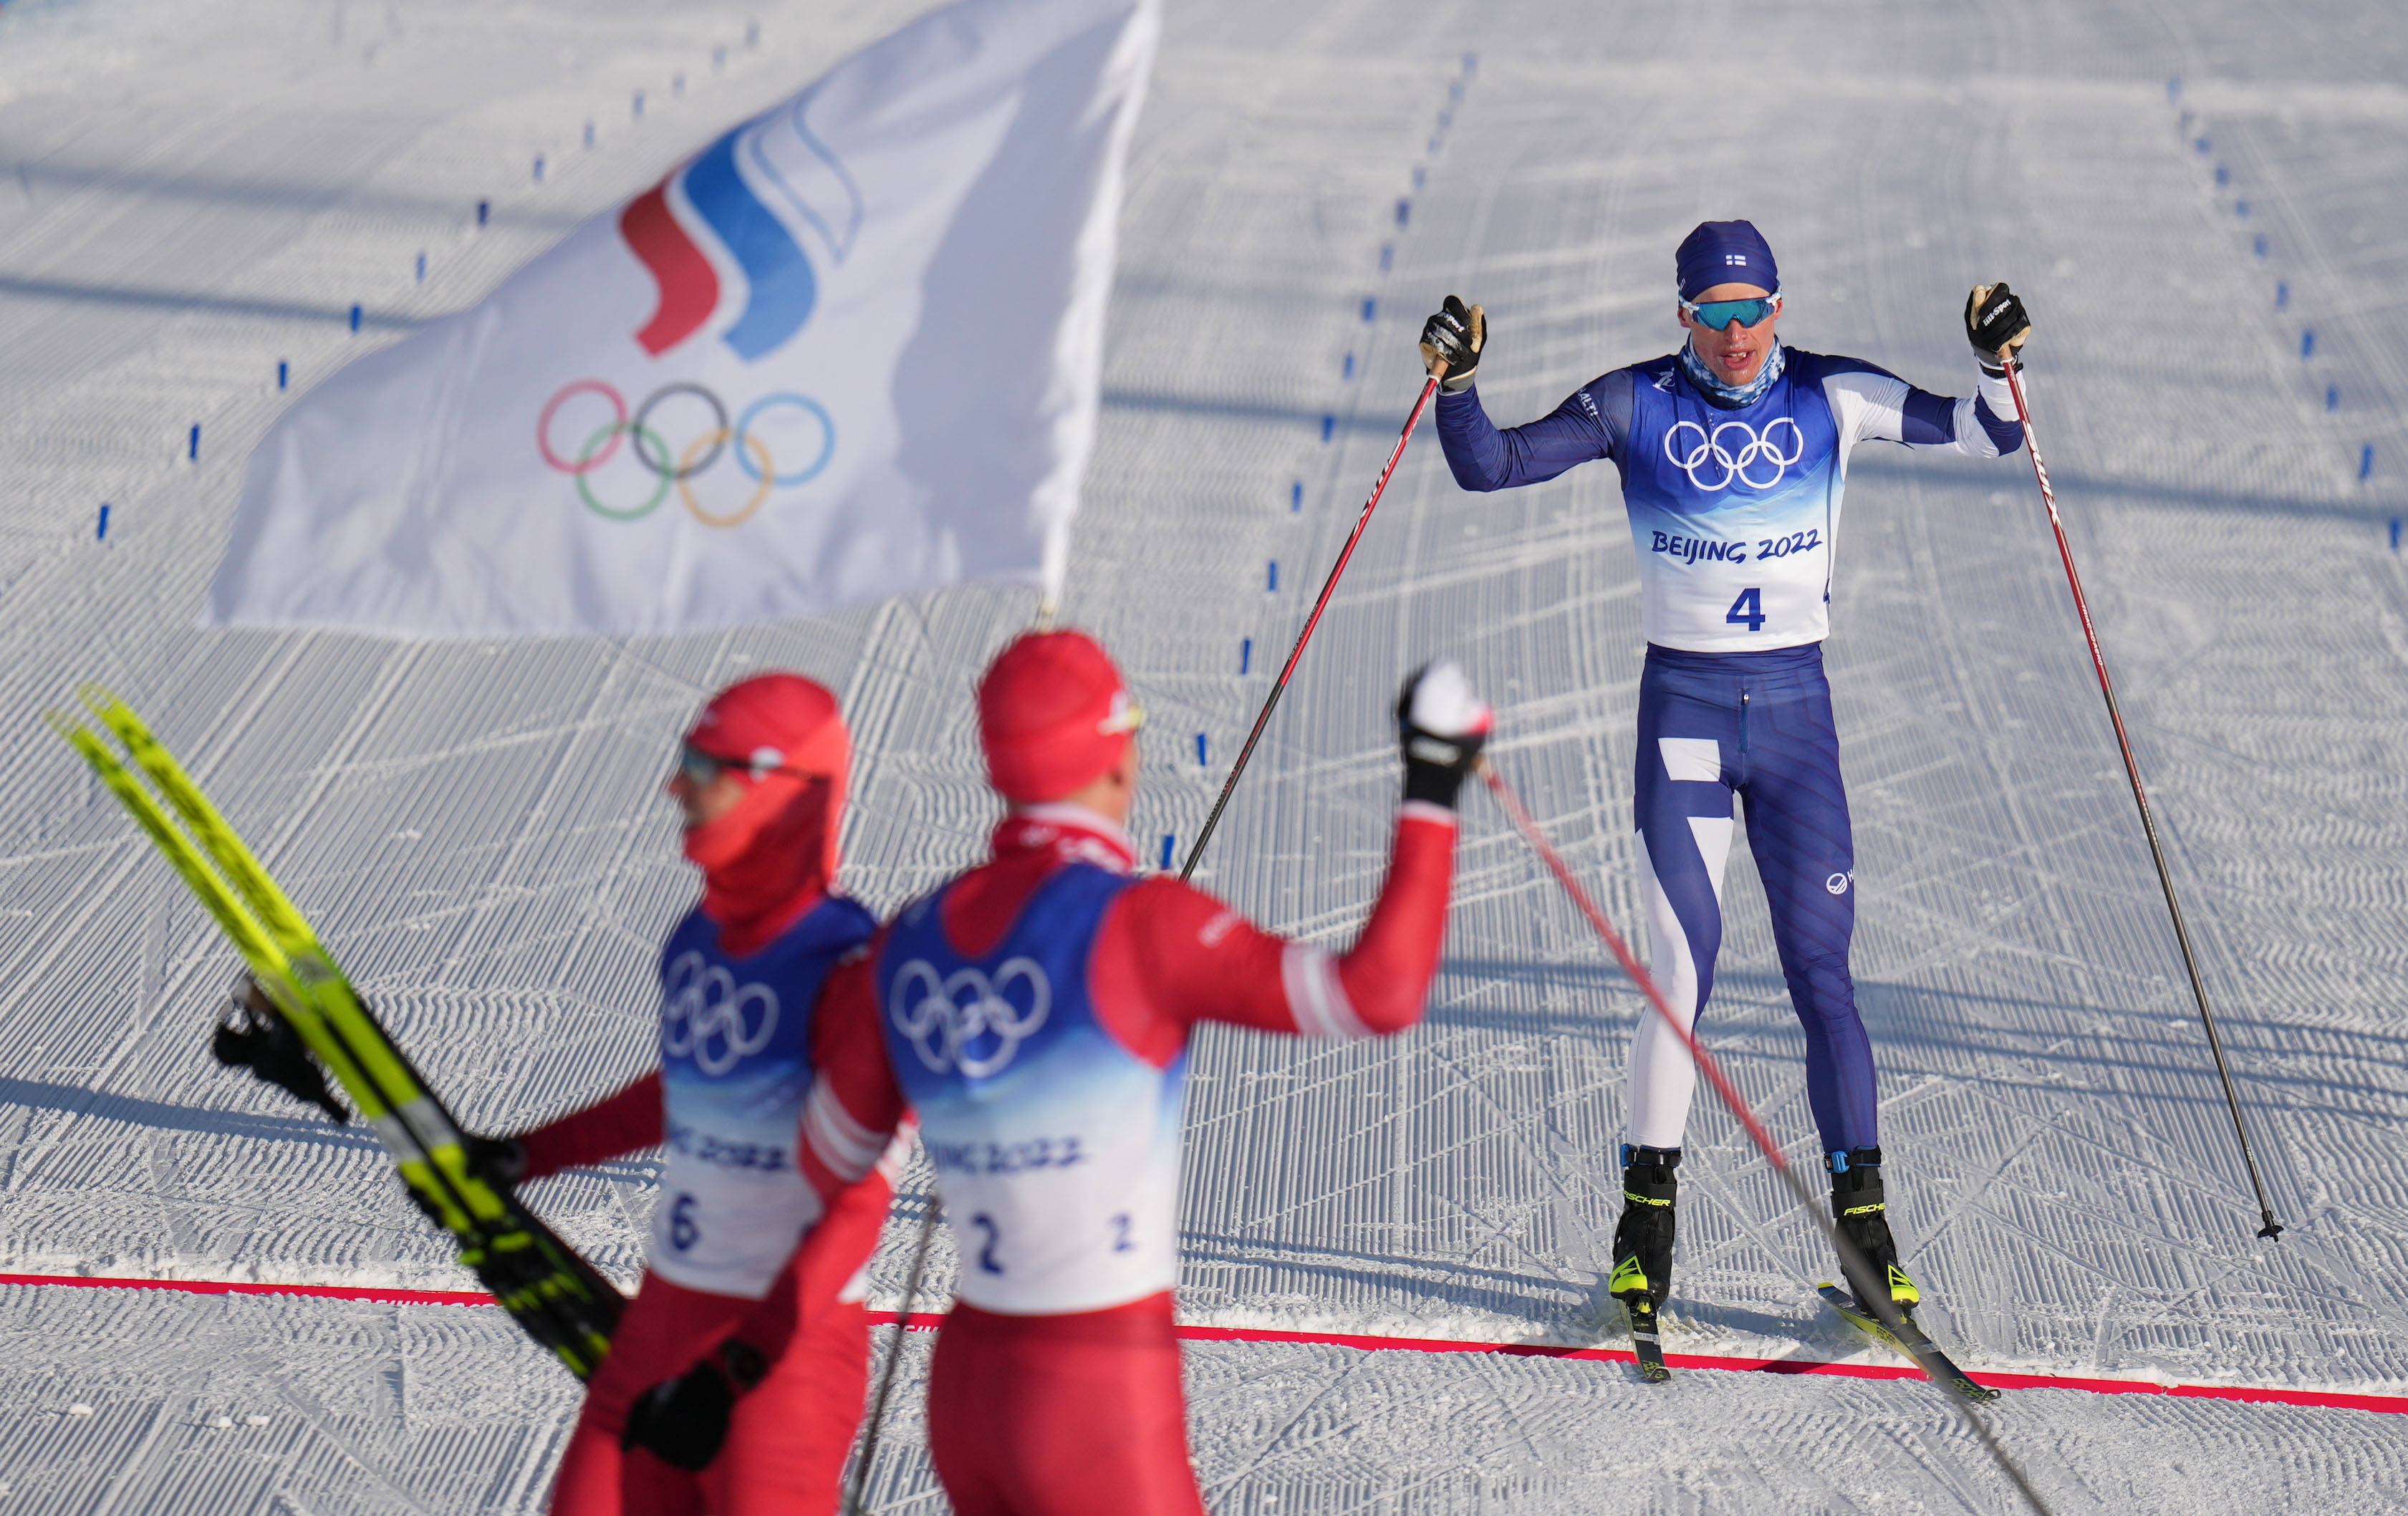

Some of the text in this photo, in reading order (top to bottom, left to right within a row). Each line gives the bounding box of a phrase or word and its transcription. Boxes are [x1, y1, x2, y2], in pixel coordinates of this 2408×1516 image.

[1652, 529, 1823, 565] BEIJING 2022
[1726, 588, 1766, 632] 4
[669, 1192, 699, 1251] 6
[1844, 1203, 1885, 1216] FISCHE
[970, 1212, 1004, 1274] 2
[1109, 1213, 1137, 1252] 2
